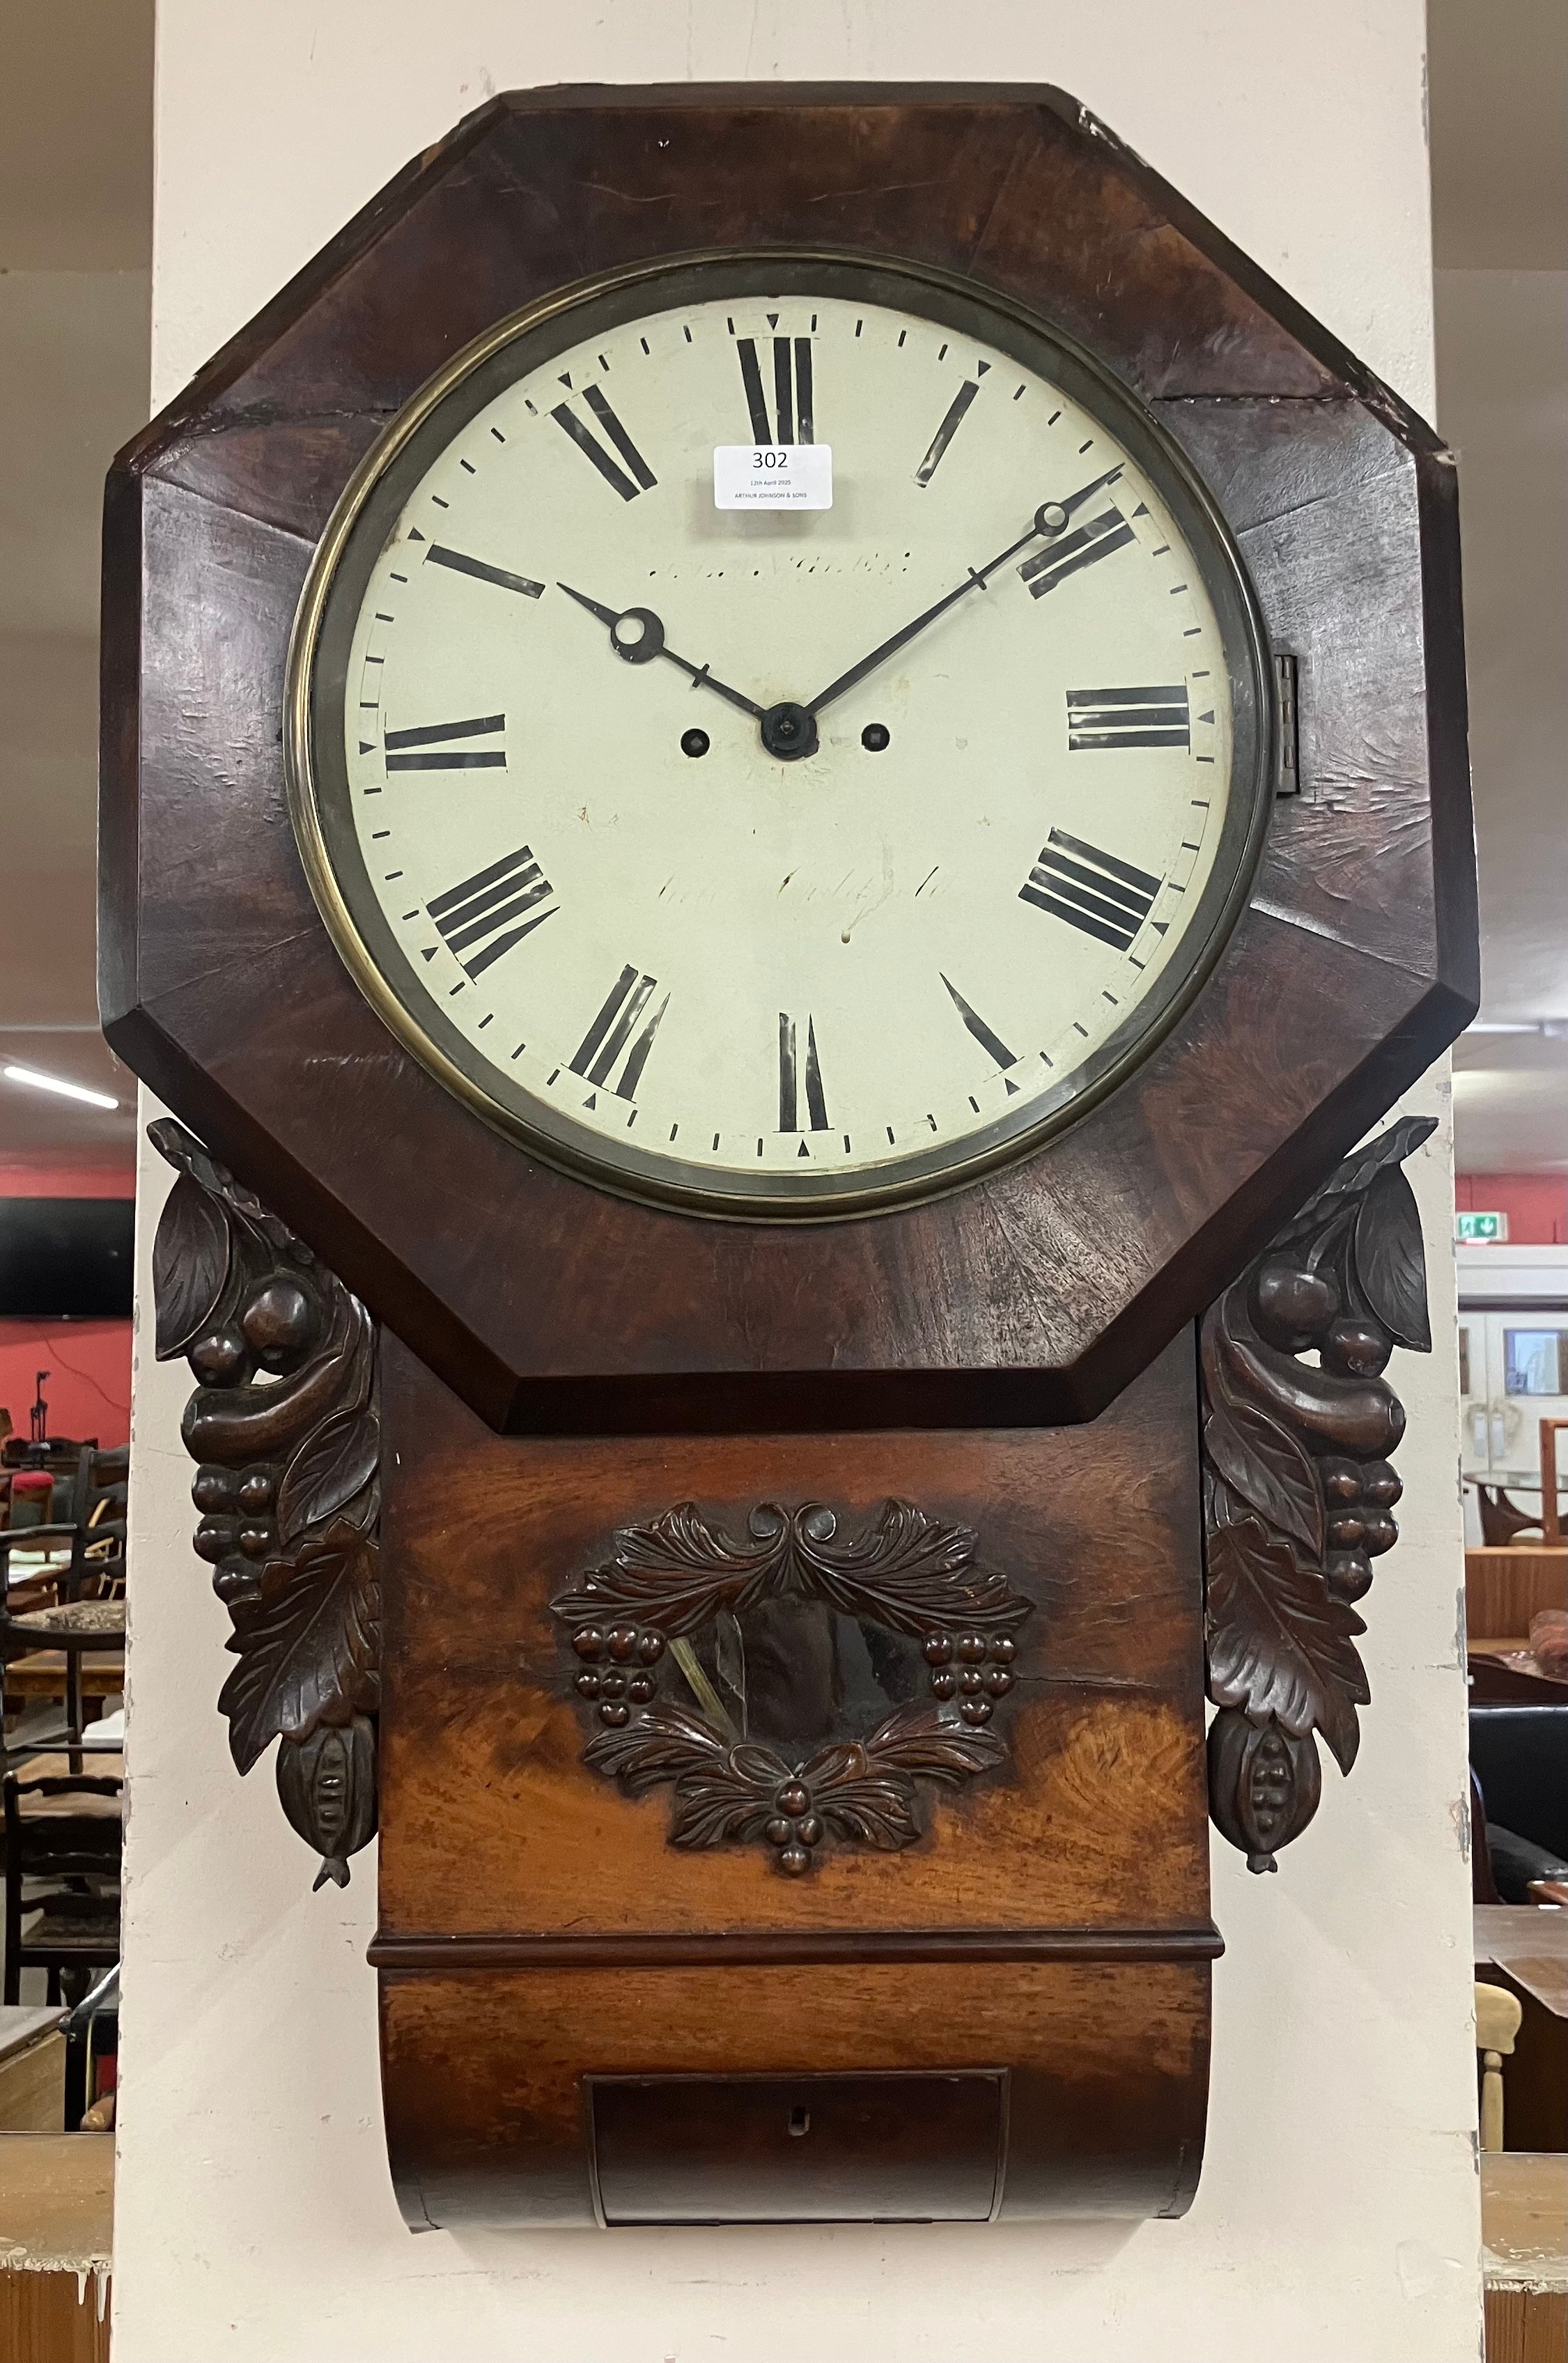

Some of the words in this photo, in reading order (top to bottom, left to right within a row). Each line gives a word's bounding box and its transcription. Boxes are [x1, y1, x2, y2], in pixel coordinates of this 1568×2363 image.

[752, 452, 788, 468] 302
[1065, 685, 1191, 757] III
[1017, 826, 1167, 953] IIII
